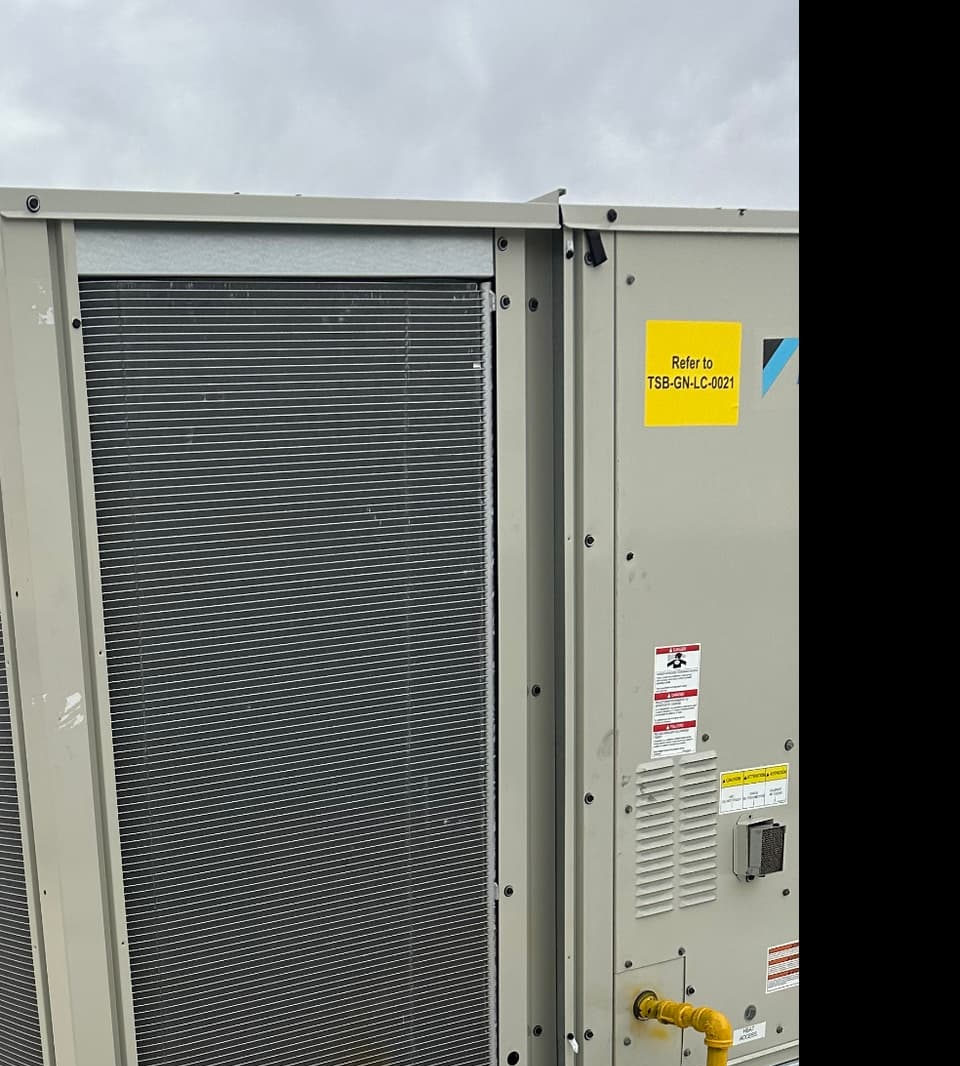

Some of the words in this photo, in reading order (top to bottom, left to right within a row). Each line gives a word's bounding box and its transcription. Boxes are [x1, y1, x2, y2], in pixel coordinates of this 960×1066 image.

[672, 356, 700, 369] Refer
[703, 357, 713, 369] to
[648, 376, 734, 389] TSB-GN-LC-0021
